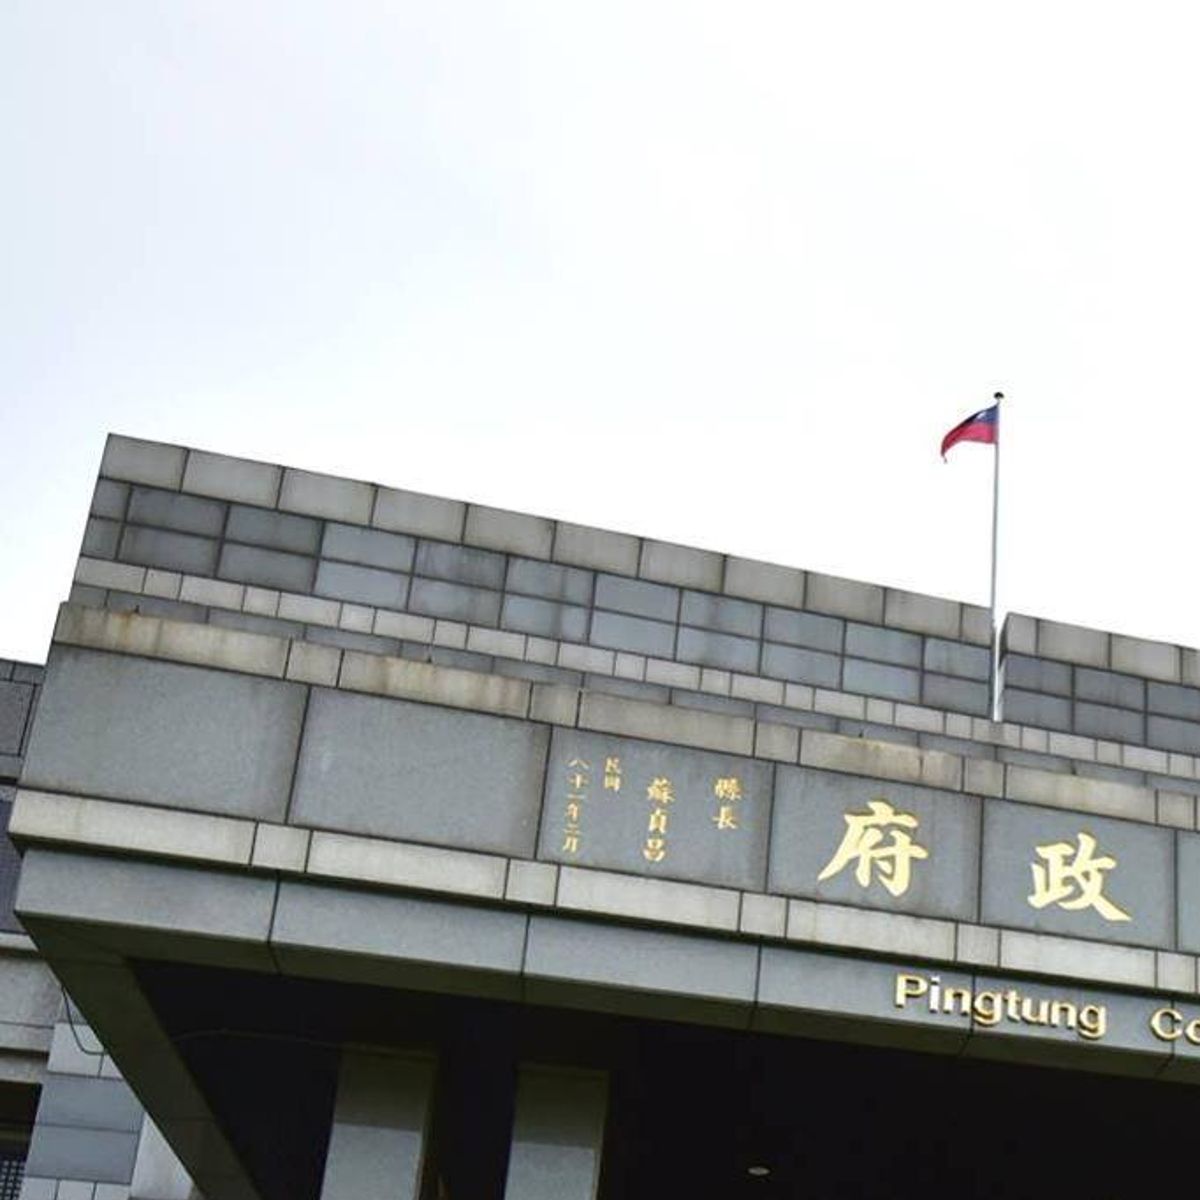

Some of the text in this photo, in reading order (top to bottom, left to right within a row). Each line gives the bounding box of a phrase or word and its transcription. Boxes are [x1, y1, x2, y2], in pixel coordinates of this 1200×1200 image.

[642, 777, 676, 863] 蘇貞昌
[894, 972, 1108, 1039] Pingtung
